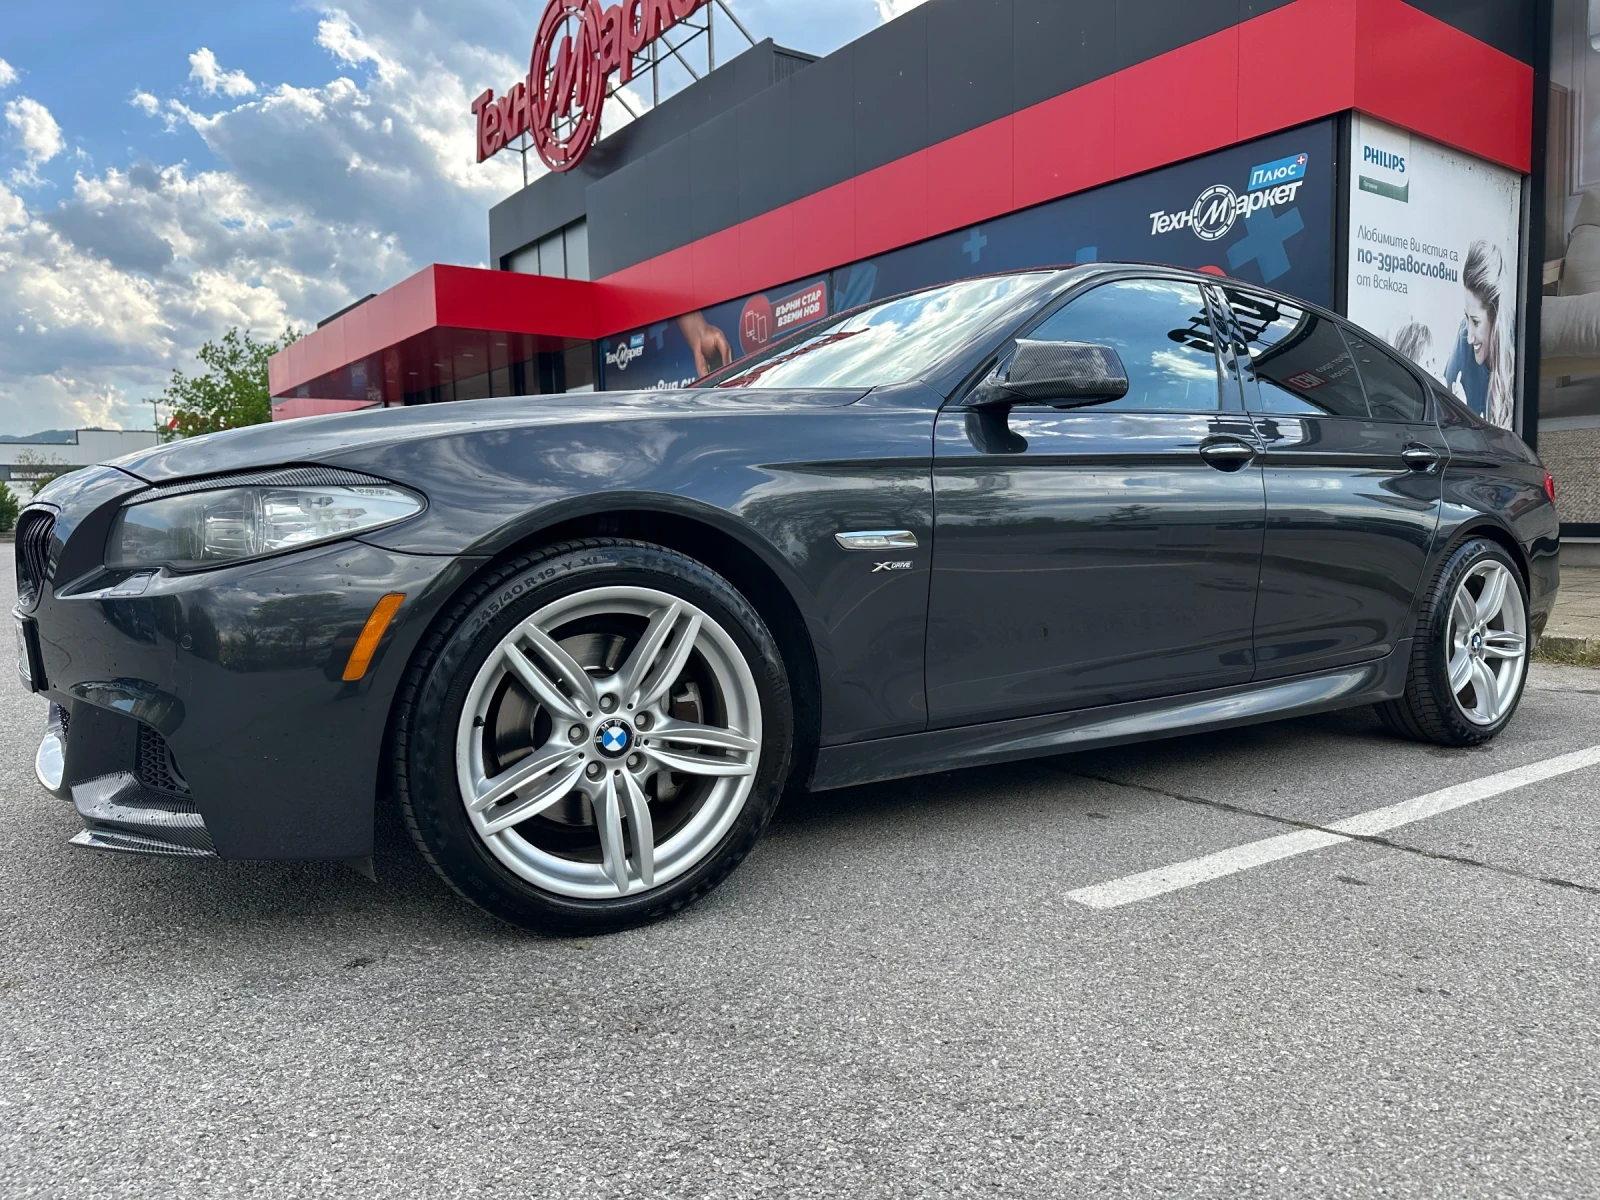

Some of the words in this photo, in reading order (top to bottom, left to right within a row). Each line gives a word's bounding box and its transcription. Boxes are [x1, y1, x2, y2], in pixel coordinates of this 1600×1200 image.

[1364, 146, 1405, 173] PHILIPS
[1252, 164, 1297, 185] Плюс
[1358, 225, 1408, 249] Любимите
[1410, 237, 1420, 252] ви
[1422, 243, 1447, 258] ястия
[1449, 250, 1458, 261] са
[1357, 248, 1458, 282] по-здравословни
[1357, 274, 1371, 287] от
[1373, 274, 1408, 294] всякога
[776, 298, 801, 317] ВЪРНИ
[802, 290, 821, 306] СТАР
[778, 308, 803, 327] ВЗЕМИ
[804, 302, 820, 317] НОВ
[472, 584, 524, 629] 245/40
[596, 719, 622, 743] BMW
